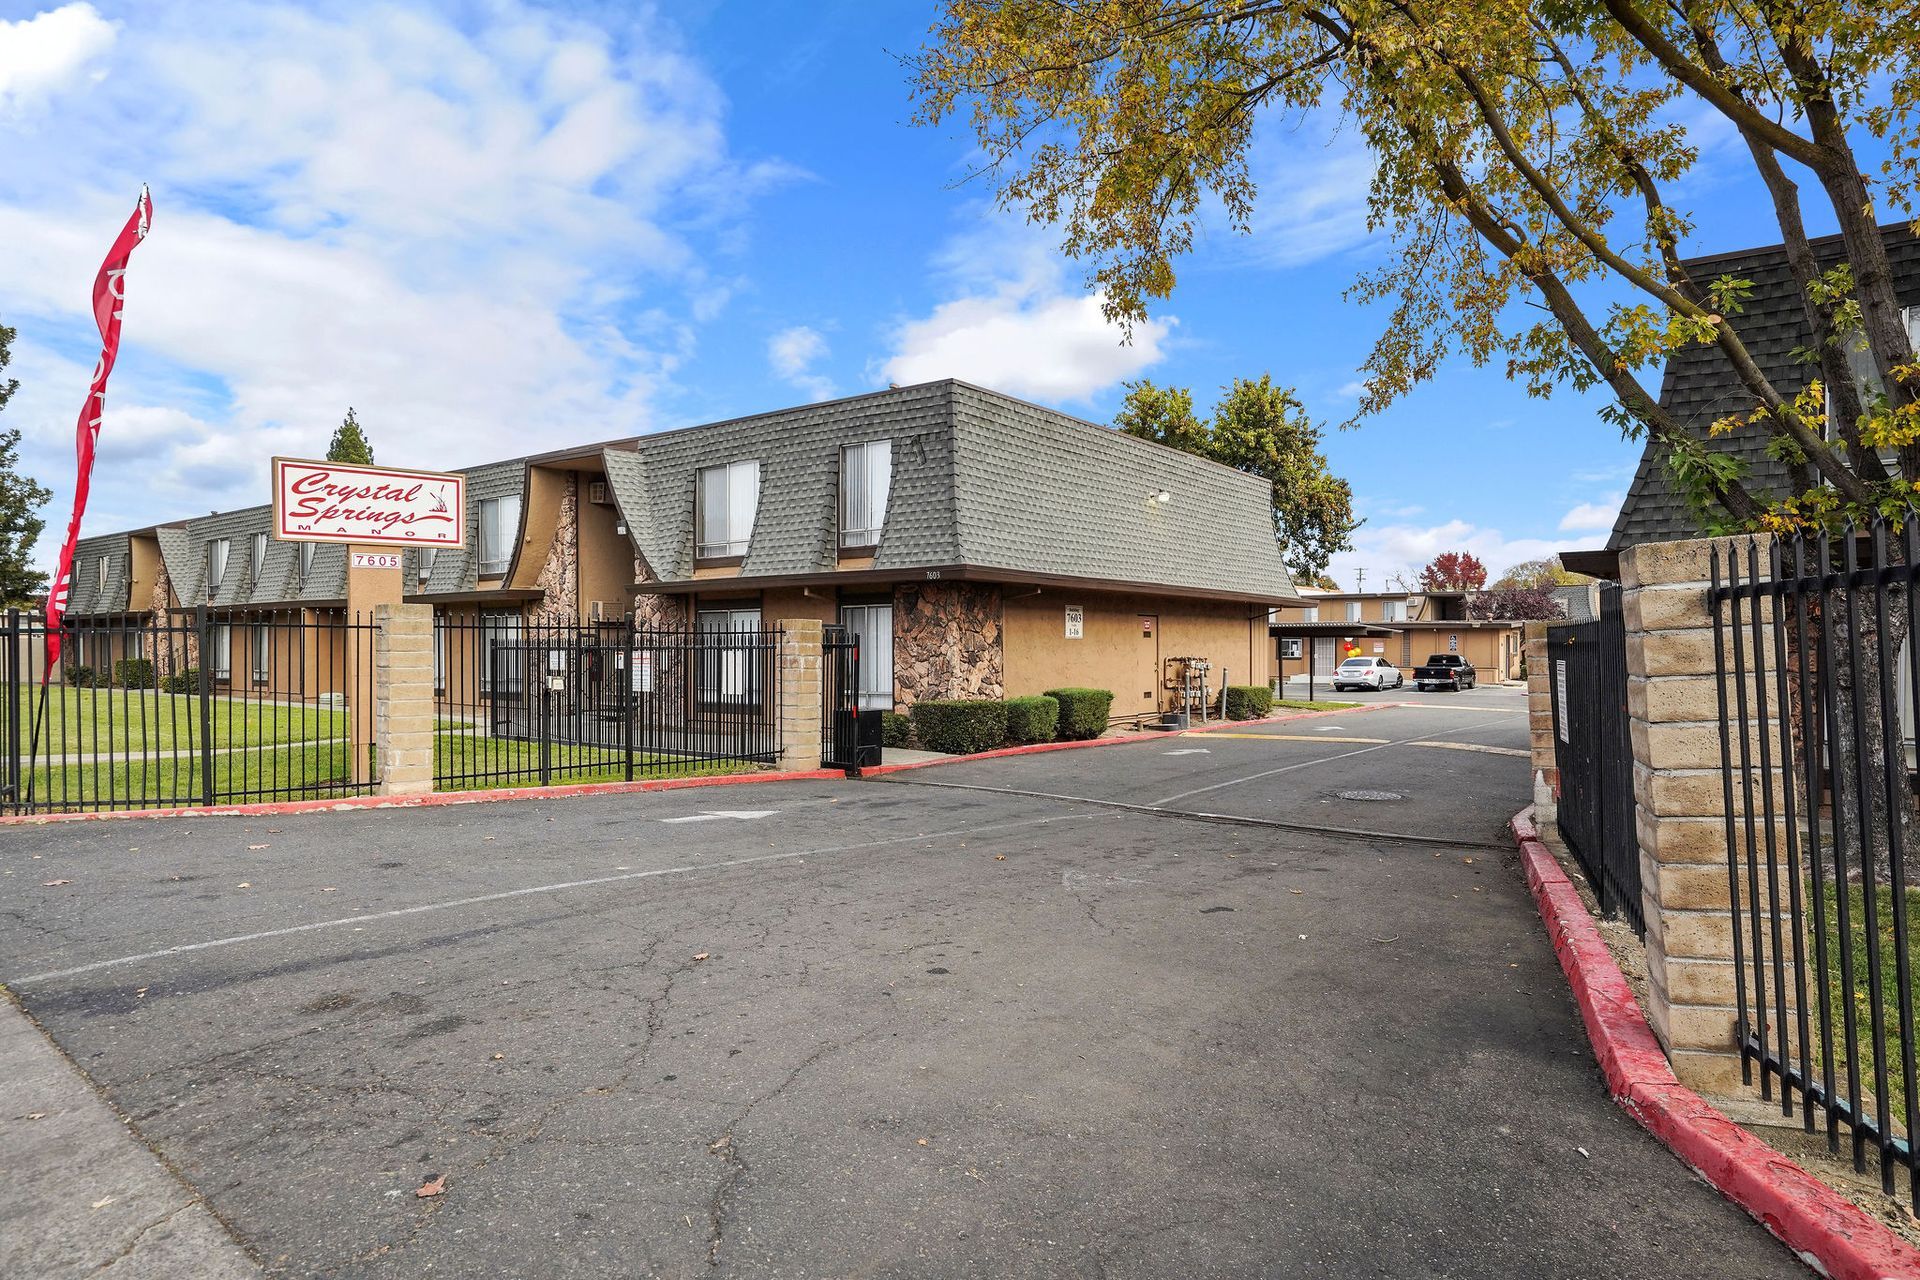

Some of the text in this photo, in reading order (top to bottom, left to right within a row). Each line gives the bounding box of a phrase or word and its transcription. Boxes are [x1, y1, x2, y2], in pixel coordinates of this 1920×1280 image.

[291, 472, 423, 504] Crystal
[288, 497, 454, 530] Springs
[298, 524, 447, 538] MANOR
[355, 555, 398, 567] 7605
[926, 571, 941, 580] 7603
[1066, 613, 1082, 623] 7603
